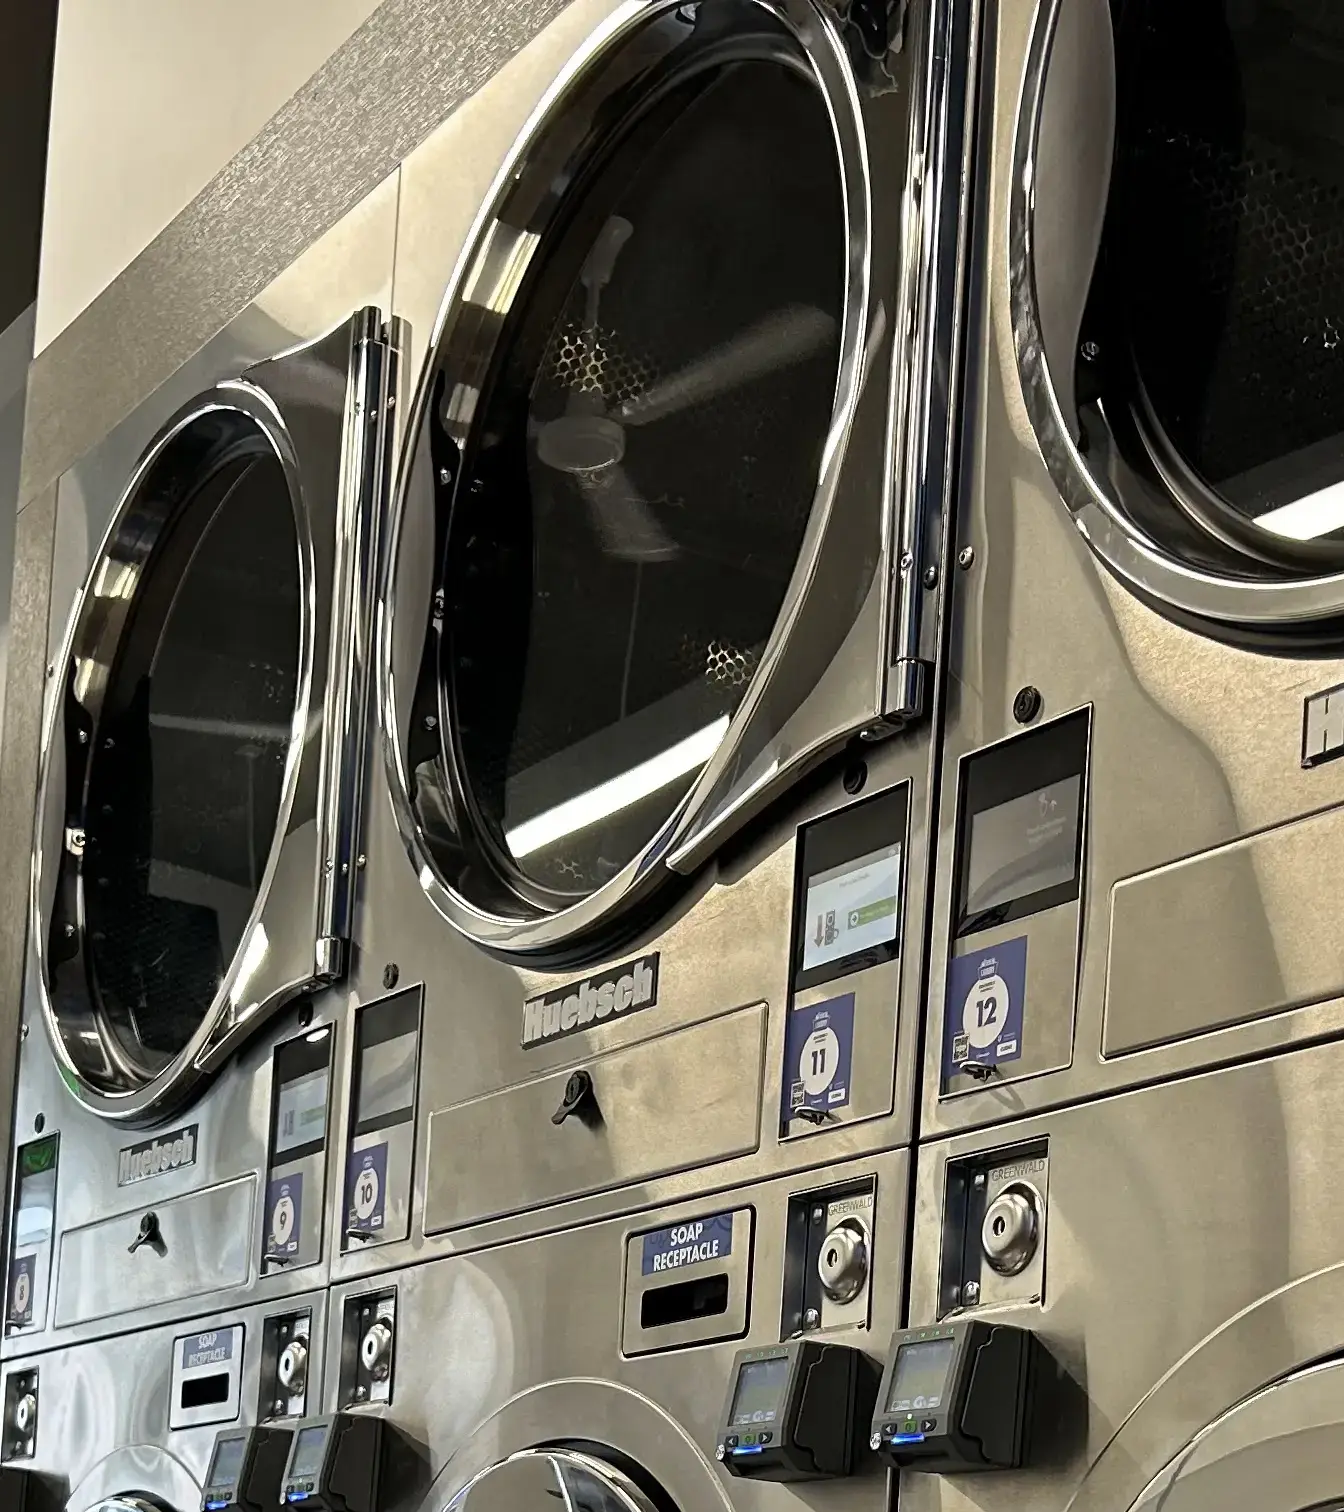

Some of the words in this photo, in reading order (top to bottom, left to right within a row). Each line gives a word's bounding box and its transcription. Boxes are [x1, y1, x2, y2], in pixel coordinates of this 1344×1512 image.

[523, 960, 654, 1043] Huebsch
[975, 996, 997, 1028] 12
[811, 1048, 827, 1076] 11
[991, 1158, 1046, 1184] GREENWALD
[360, 1182, 373, 1206] 10
[279, 1210, 288, 1231] 9
[669, 1222, 704, 1245] SOAP
[652, 1238, 720, 1273] RECEPTACLE
